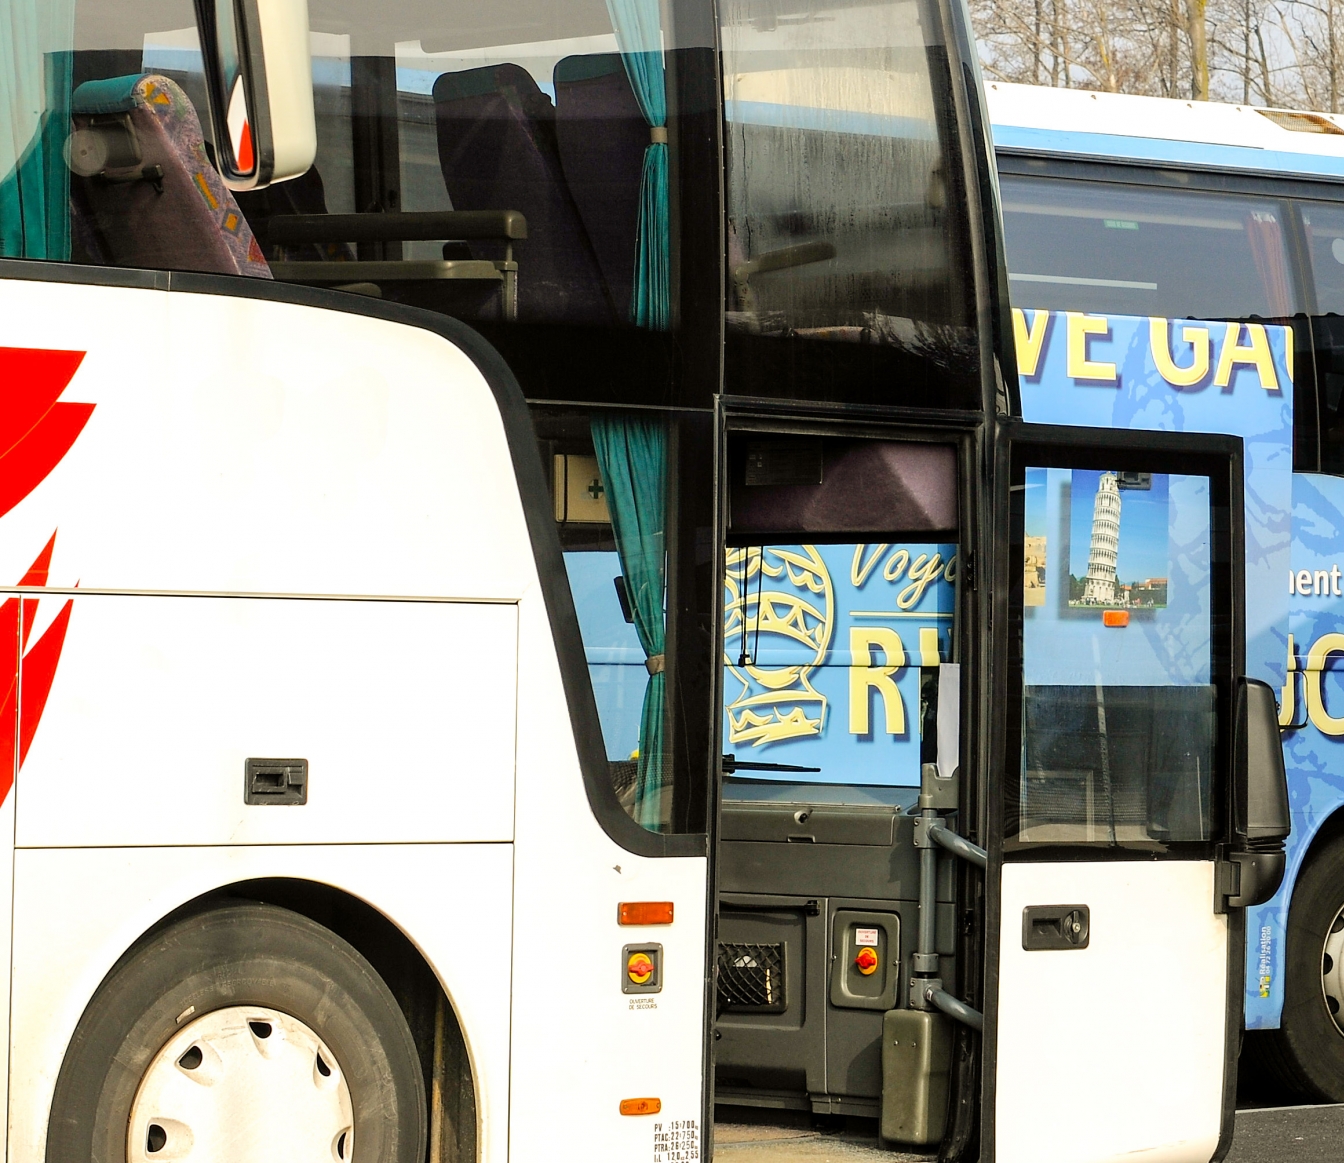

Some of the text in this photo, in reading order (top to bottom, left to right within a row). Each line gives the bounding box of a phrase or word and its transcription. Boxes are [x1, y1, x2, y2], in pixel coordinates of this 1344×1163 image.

[1148, 316, 1294, 390] GA
[1259, 926, 1267, 975] Réalisation
[654, 1123, 662, 1132] PV
